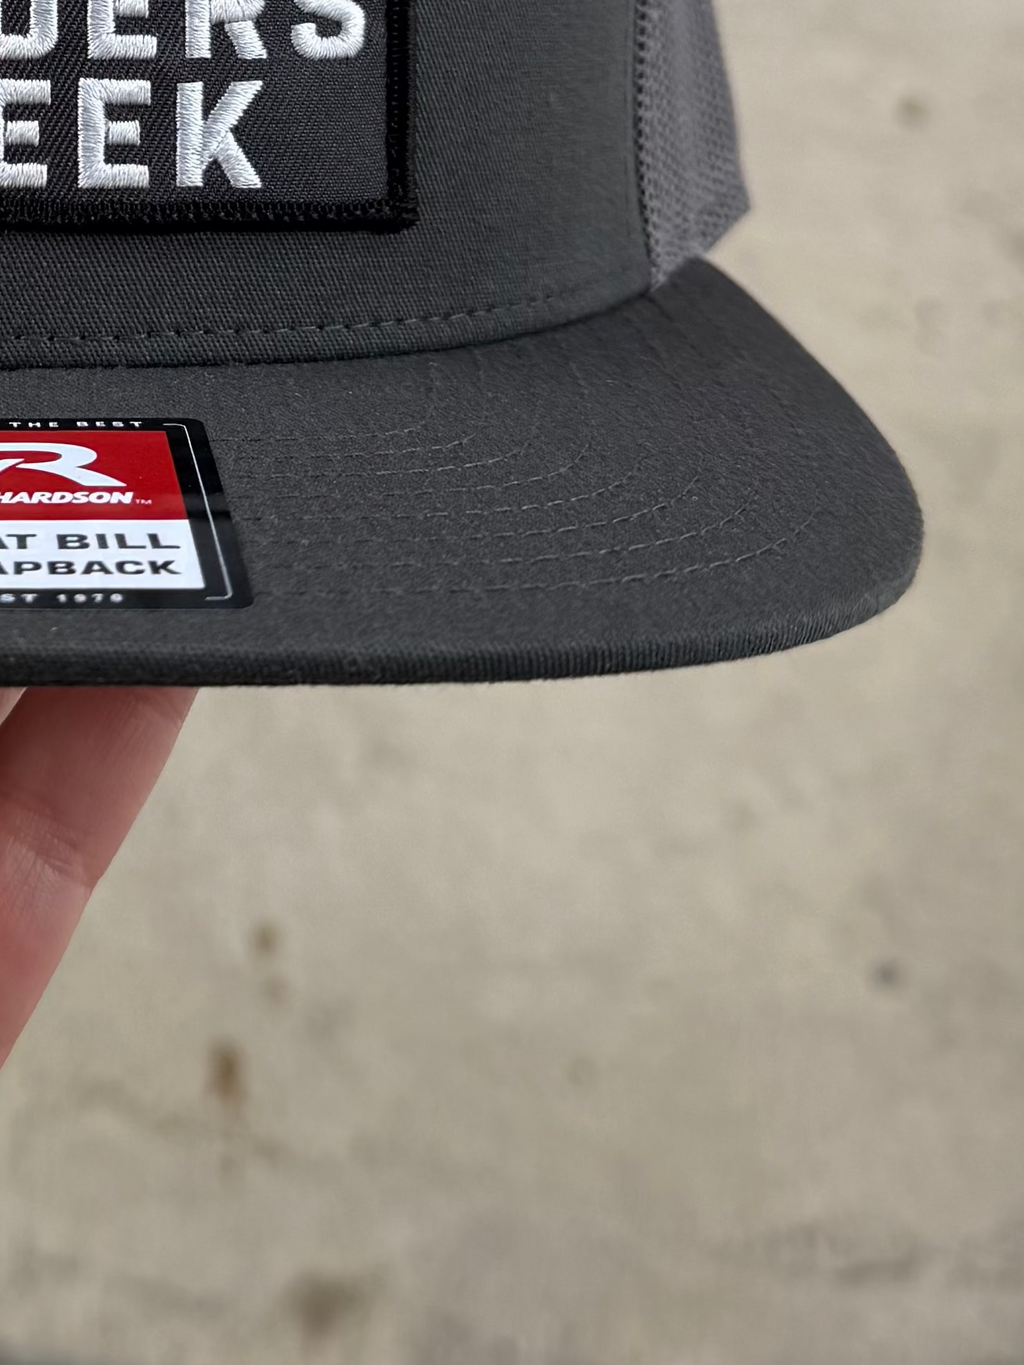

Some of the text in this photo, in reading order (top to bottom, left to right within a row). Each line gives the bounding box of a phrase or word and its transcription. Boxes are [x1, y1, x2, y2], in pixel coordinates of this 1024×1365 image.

[9, 420, 60, 429] THE
[76, 420, 144, 429] BEST
[56, 533, 181, 550] BILL
